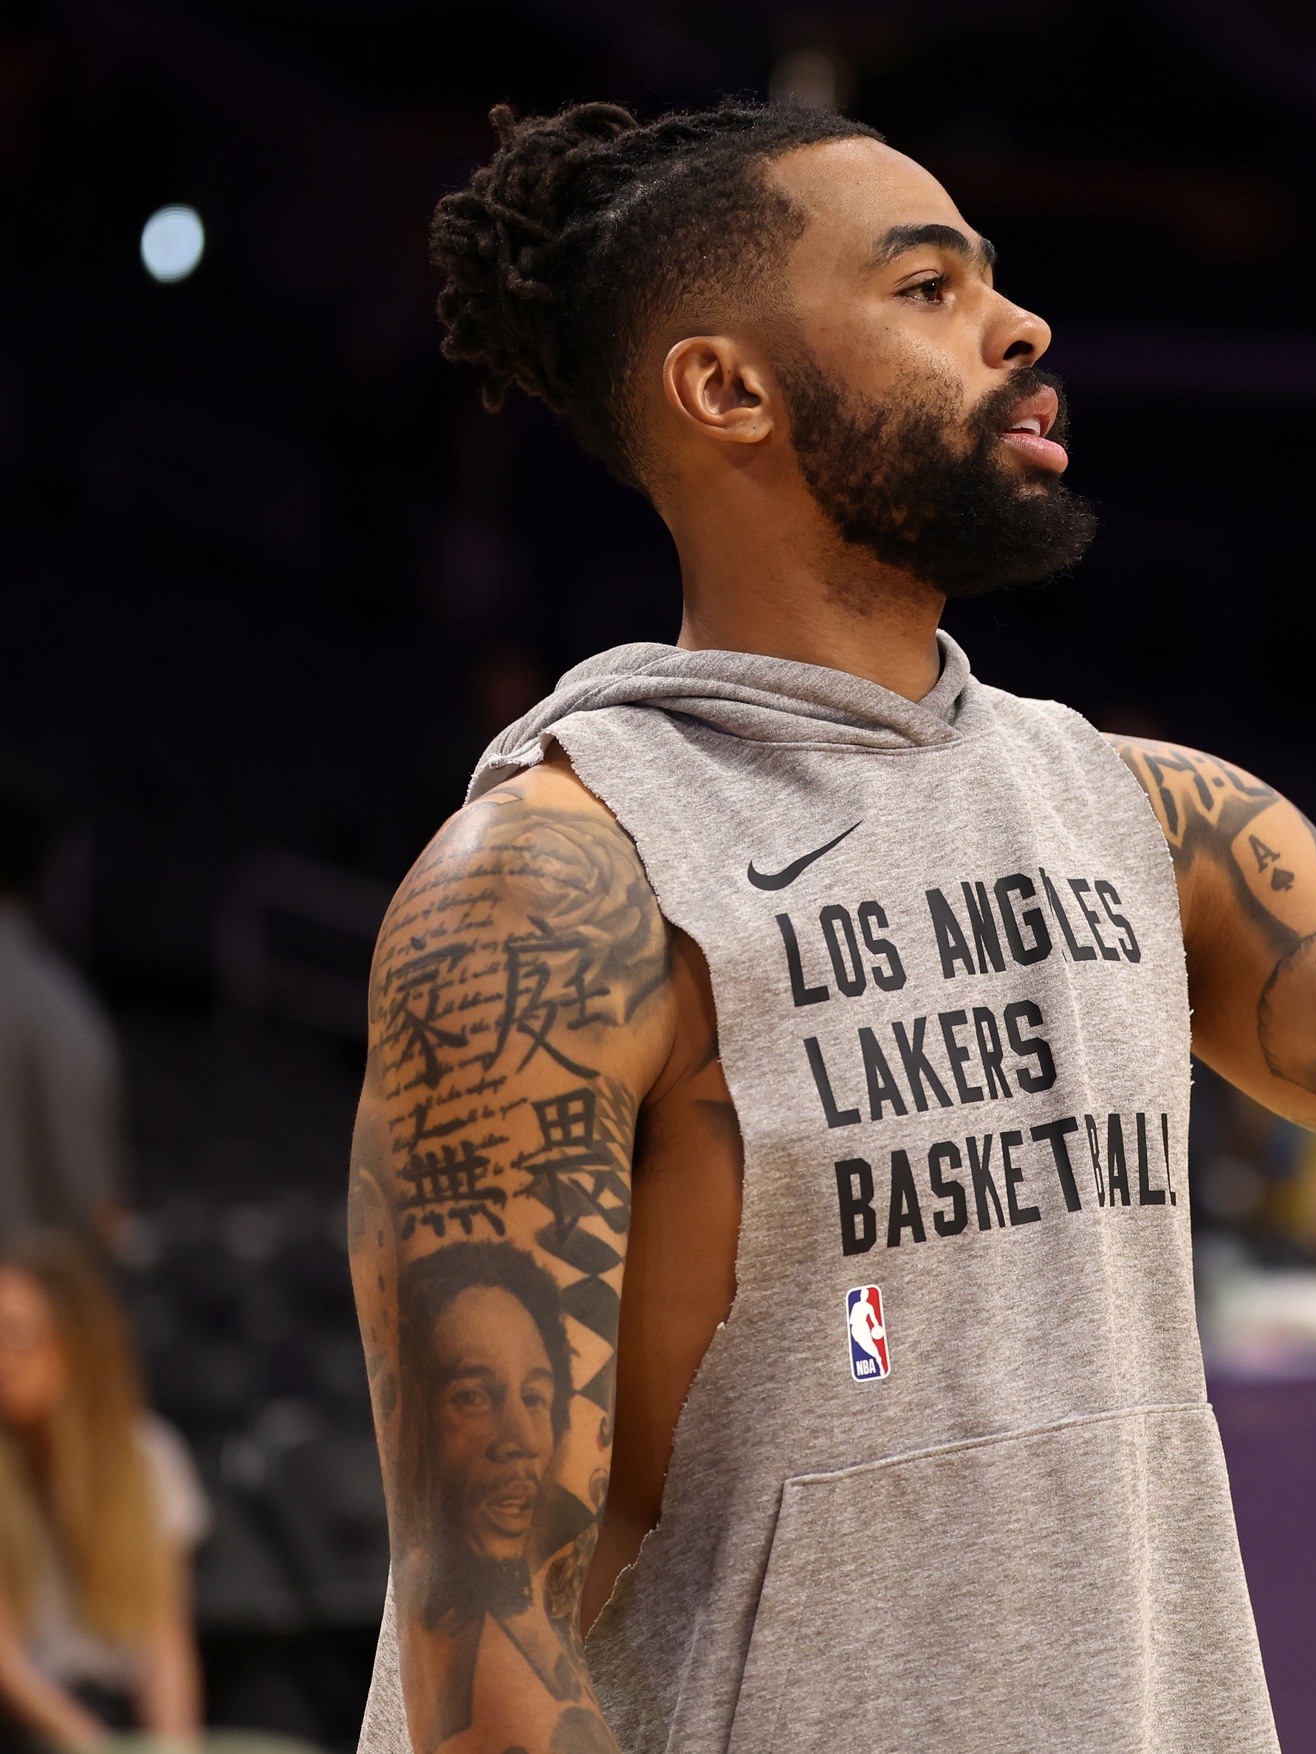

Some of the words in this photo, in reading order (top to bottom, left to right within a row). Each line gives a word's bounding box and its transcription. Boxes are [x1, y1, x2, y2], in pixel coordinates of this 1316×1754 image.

[1249, 834, 1281, 873] A
[775, 901, 906, 1007] LOS
[926, 868, 1141, 979] ANGLES
[804, 1000, 1058, 1128] LAKERS
[856, 1358, 877, 1376] NBA
